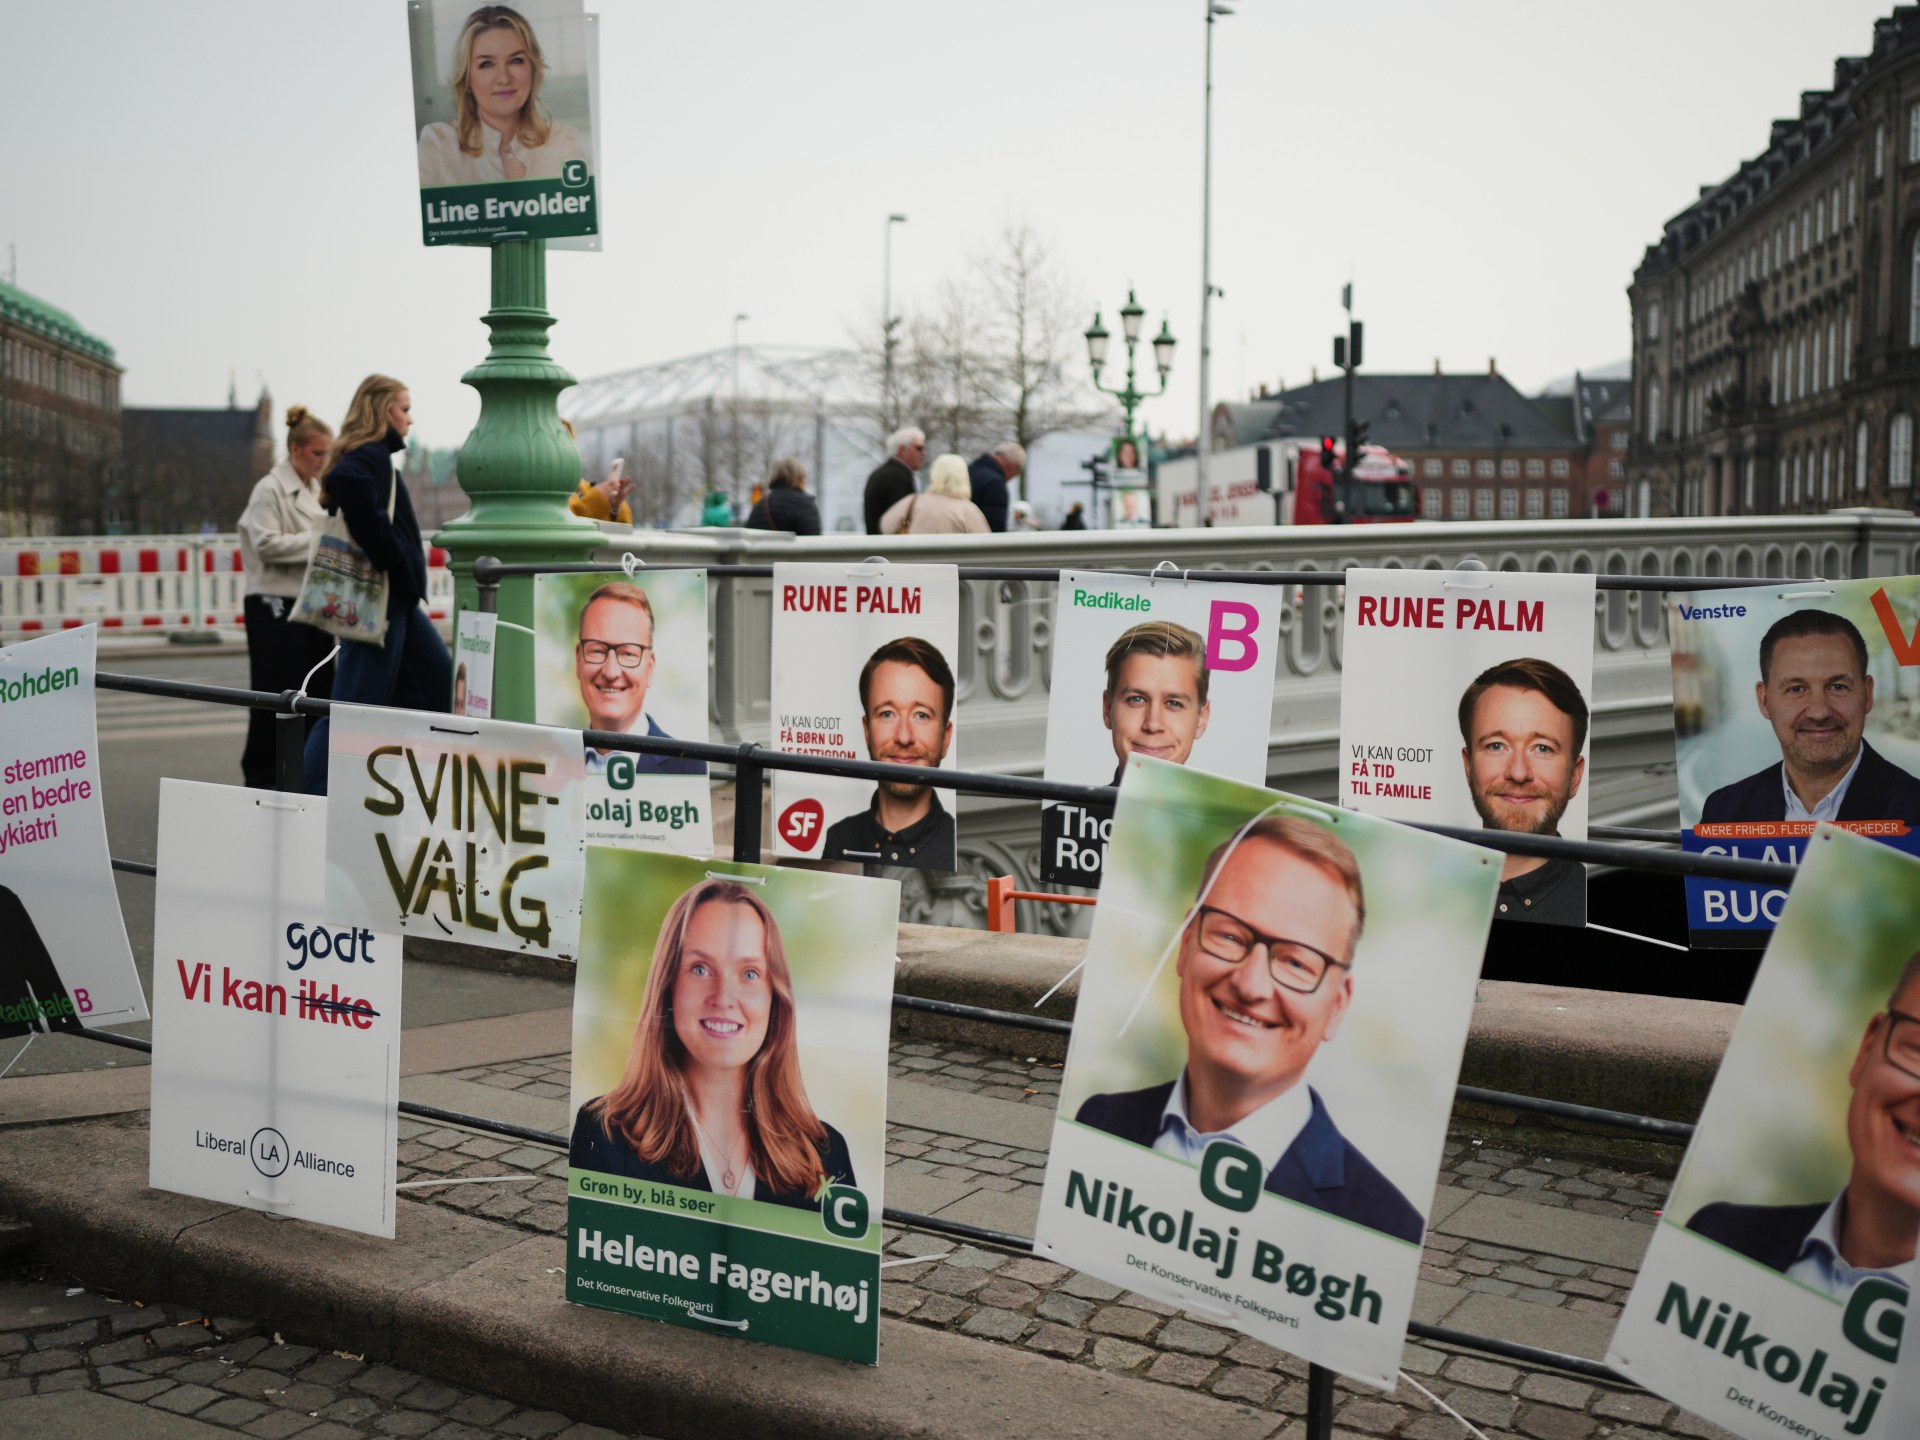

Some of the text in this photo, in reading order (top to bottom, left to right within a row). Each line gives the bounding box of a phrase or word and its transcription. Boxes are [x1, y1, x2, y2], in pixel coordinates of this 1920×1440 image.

[567, 164, 582, 181] C
[427, 192, 591, 223] Line Ervolder
[783, 585, 921, 614] RUNE PALM
[1073, 589, 1151, 612] Radikale
[1358, 595, 1544, 632] RUNE PALM
[1678, 603, 1747, 621] Venstre
[1205, 599, 1260, 672] B
[780, 727, 844, 746] FÅ BØRN UD
[781, 714, 841, 730] VI KAN GODT
[4, 749, 87, 784] stemme
[1351, 744, 1434, 763] VI KAN GODT
[1351, 759, 1395, 779] FÅ TID
[613, 761, 628, 785] C
[2, 778, 92, 816] en bedre
[364, 745, 559, 845] SVINE-
[1350, 781, 1432, 800] TIL FAMILIE
[639, 800, 699, 830] Bøgh
[787, 811, 818, 838] SF
[1701, 825, 1732, 836] MERE
[1735, 824, 1778, 836] FRIHED.
[1781, 824, 1815, 836] FLERE
[286, 922, 376, 970] godt
[73, 988, 94, 1013] B
[176, 959, 375, 1030] Vi kan ikke
[195, 1130, 355, 1178] Liberal LA Alliance
[1213, 1153, 1249, 1200] C
[579, 1176, 716, 1214] Grøn by, blå søer
[833, 1196, 858, 1229] C
[1064, 1169, 1384, 1326] Nikolaj Bøgh
[578, 1227, 870, 1324] Helene Fagerhøj
[1126, 1252, 1300, 1330] Det Konservative Folkeparti
[576, 1276, 714, 1314] Det Konservative Folkeparti
[1655, 1280, 1888, 1436] Nikolaj
[1725, 1386, 1755, 1410] Det
